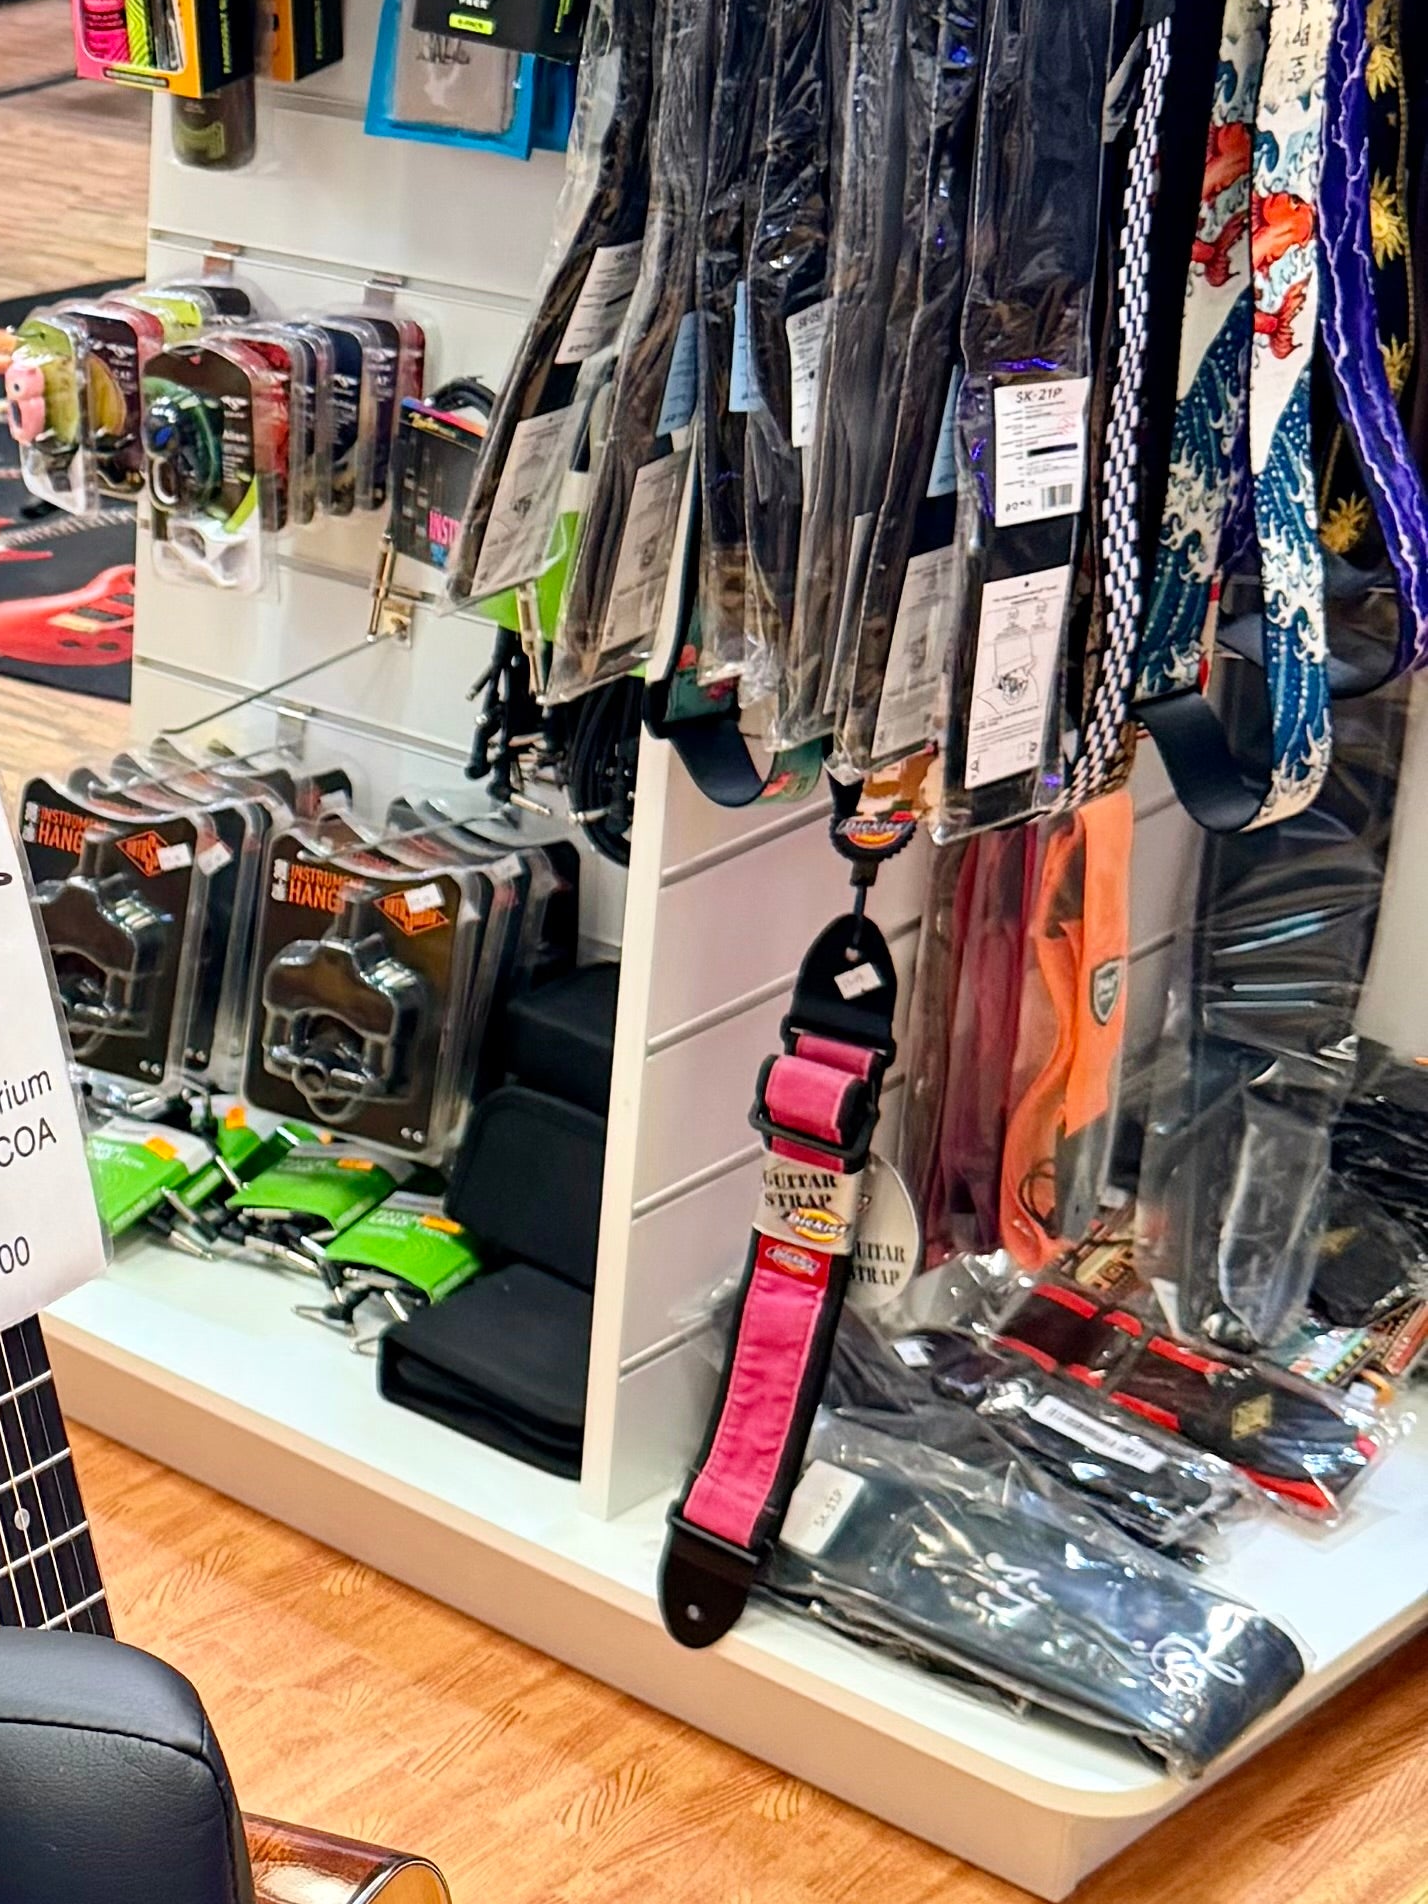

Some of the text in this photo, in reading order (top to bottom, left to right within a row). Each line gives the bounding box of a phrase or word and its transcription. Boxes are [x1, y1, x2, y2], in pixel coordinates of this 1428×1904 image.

[1015, 387, 1063, 404] SK-21P
[839, 817, 905, 838] Dickies
[37, 826, 85, 854] HANG
[287, 881, 344, 913] HANG
[764, 1192, 833, 1210] STRAP
[786, 1209, 851, 1238] Dickies
